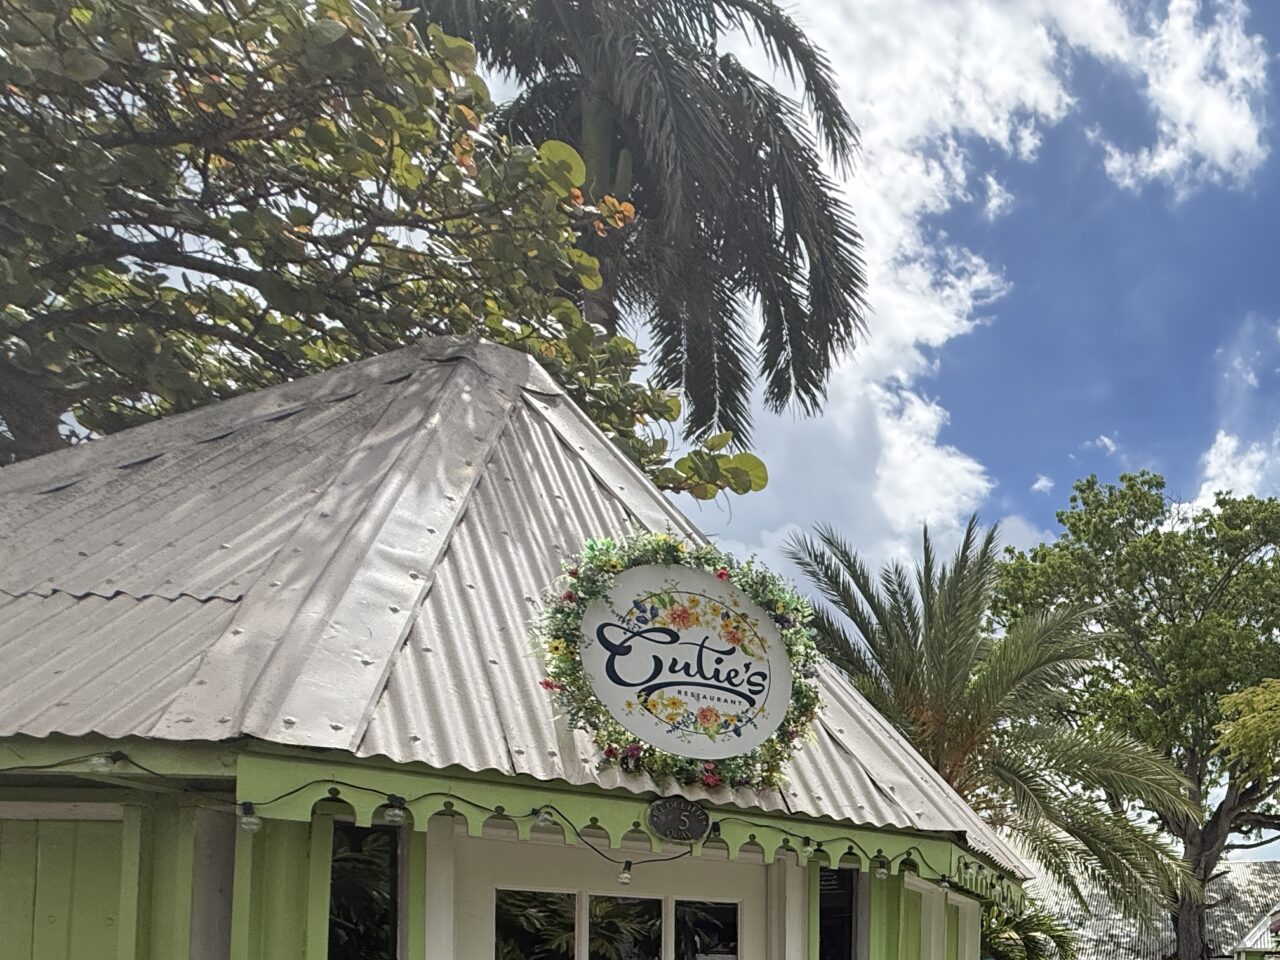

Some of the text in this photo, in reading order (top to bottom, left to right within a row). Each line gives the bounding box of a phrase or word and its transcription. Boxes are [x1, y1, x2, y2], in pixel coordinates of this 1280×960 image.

[597, 622, 767, 696] Cutie's
[677, 689, 743, 706] RESTAURANT
[678, 811, 690, 830] 5
